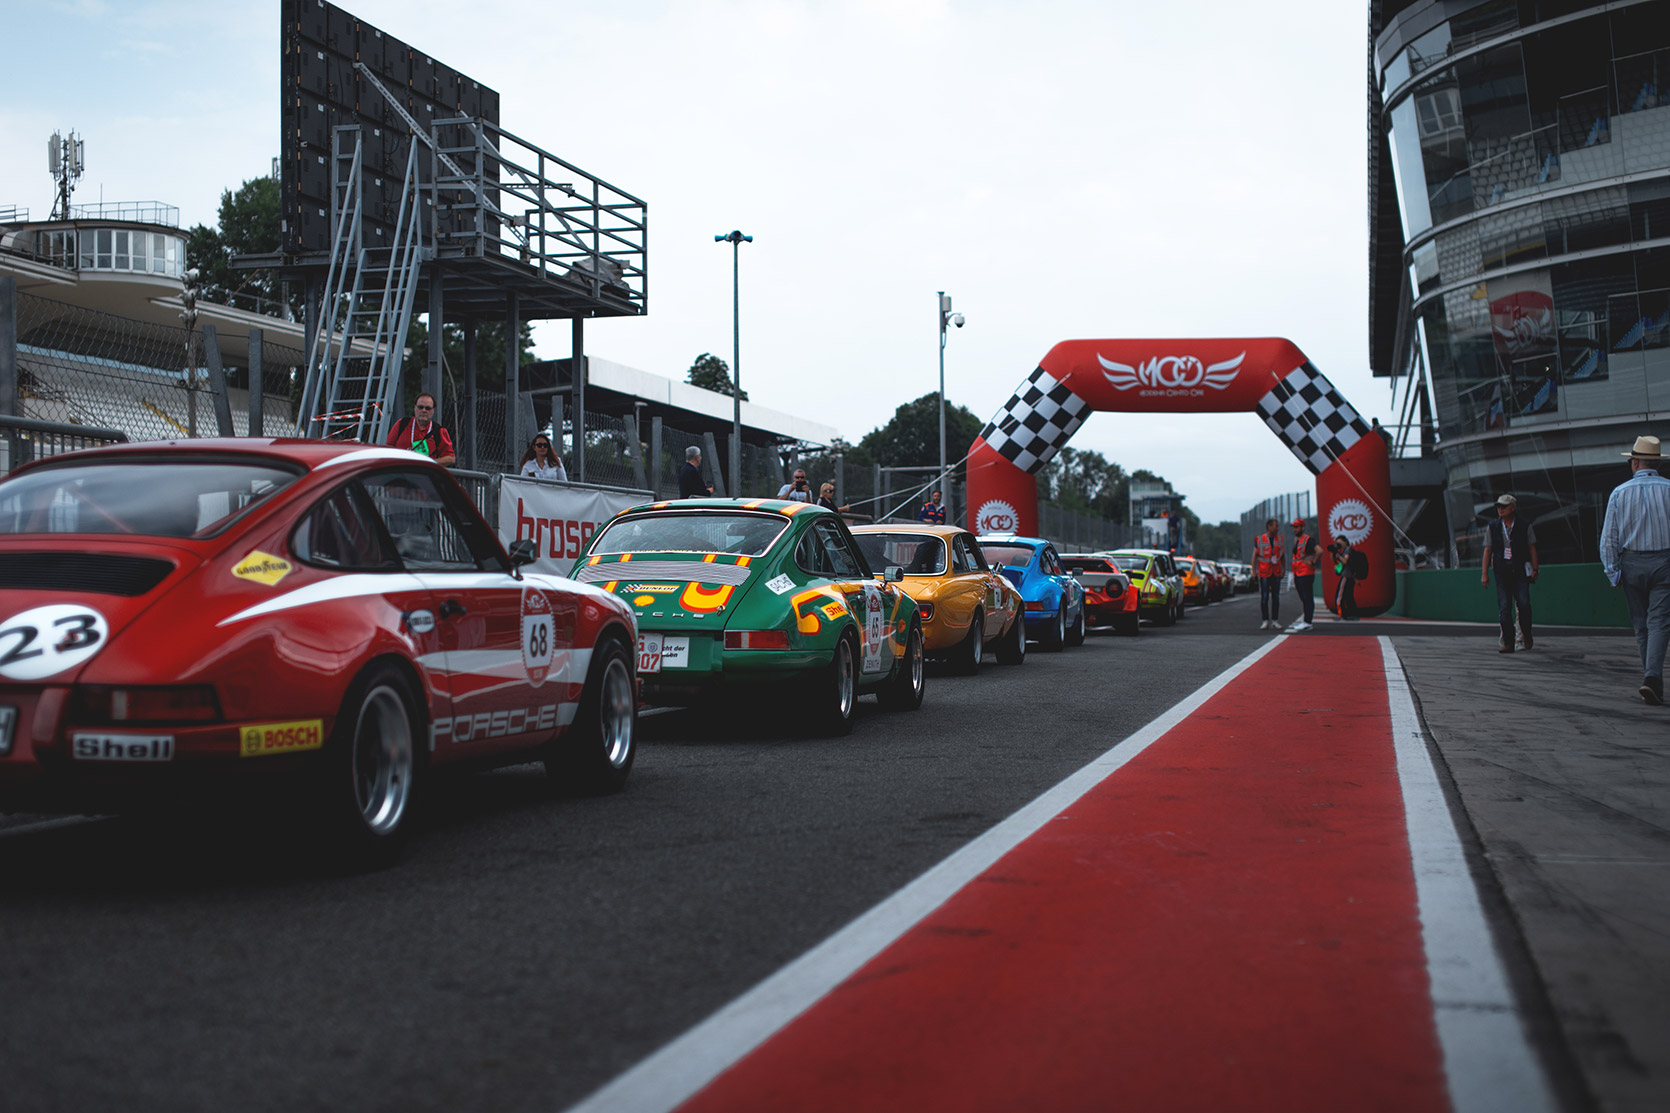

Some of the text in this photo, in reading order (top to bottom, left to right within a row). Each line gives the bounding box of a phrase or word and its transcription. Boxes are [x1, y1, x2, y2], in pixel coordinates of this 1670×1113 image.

[871, 617, 880, 638] 65
[0, 614, 101, 667] 23
[530, 622, 548, 658] 68
[637, 653, 660, 669] 07
[264, 726, 318, 748] BOSCH
[428, 704, 557, 751] PORSCHE
[77, 738, 170, 758] Shell
